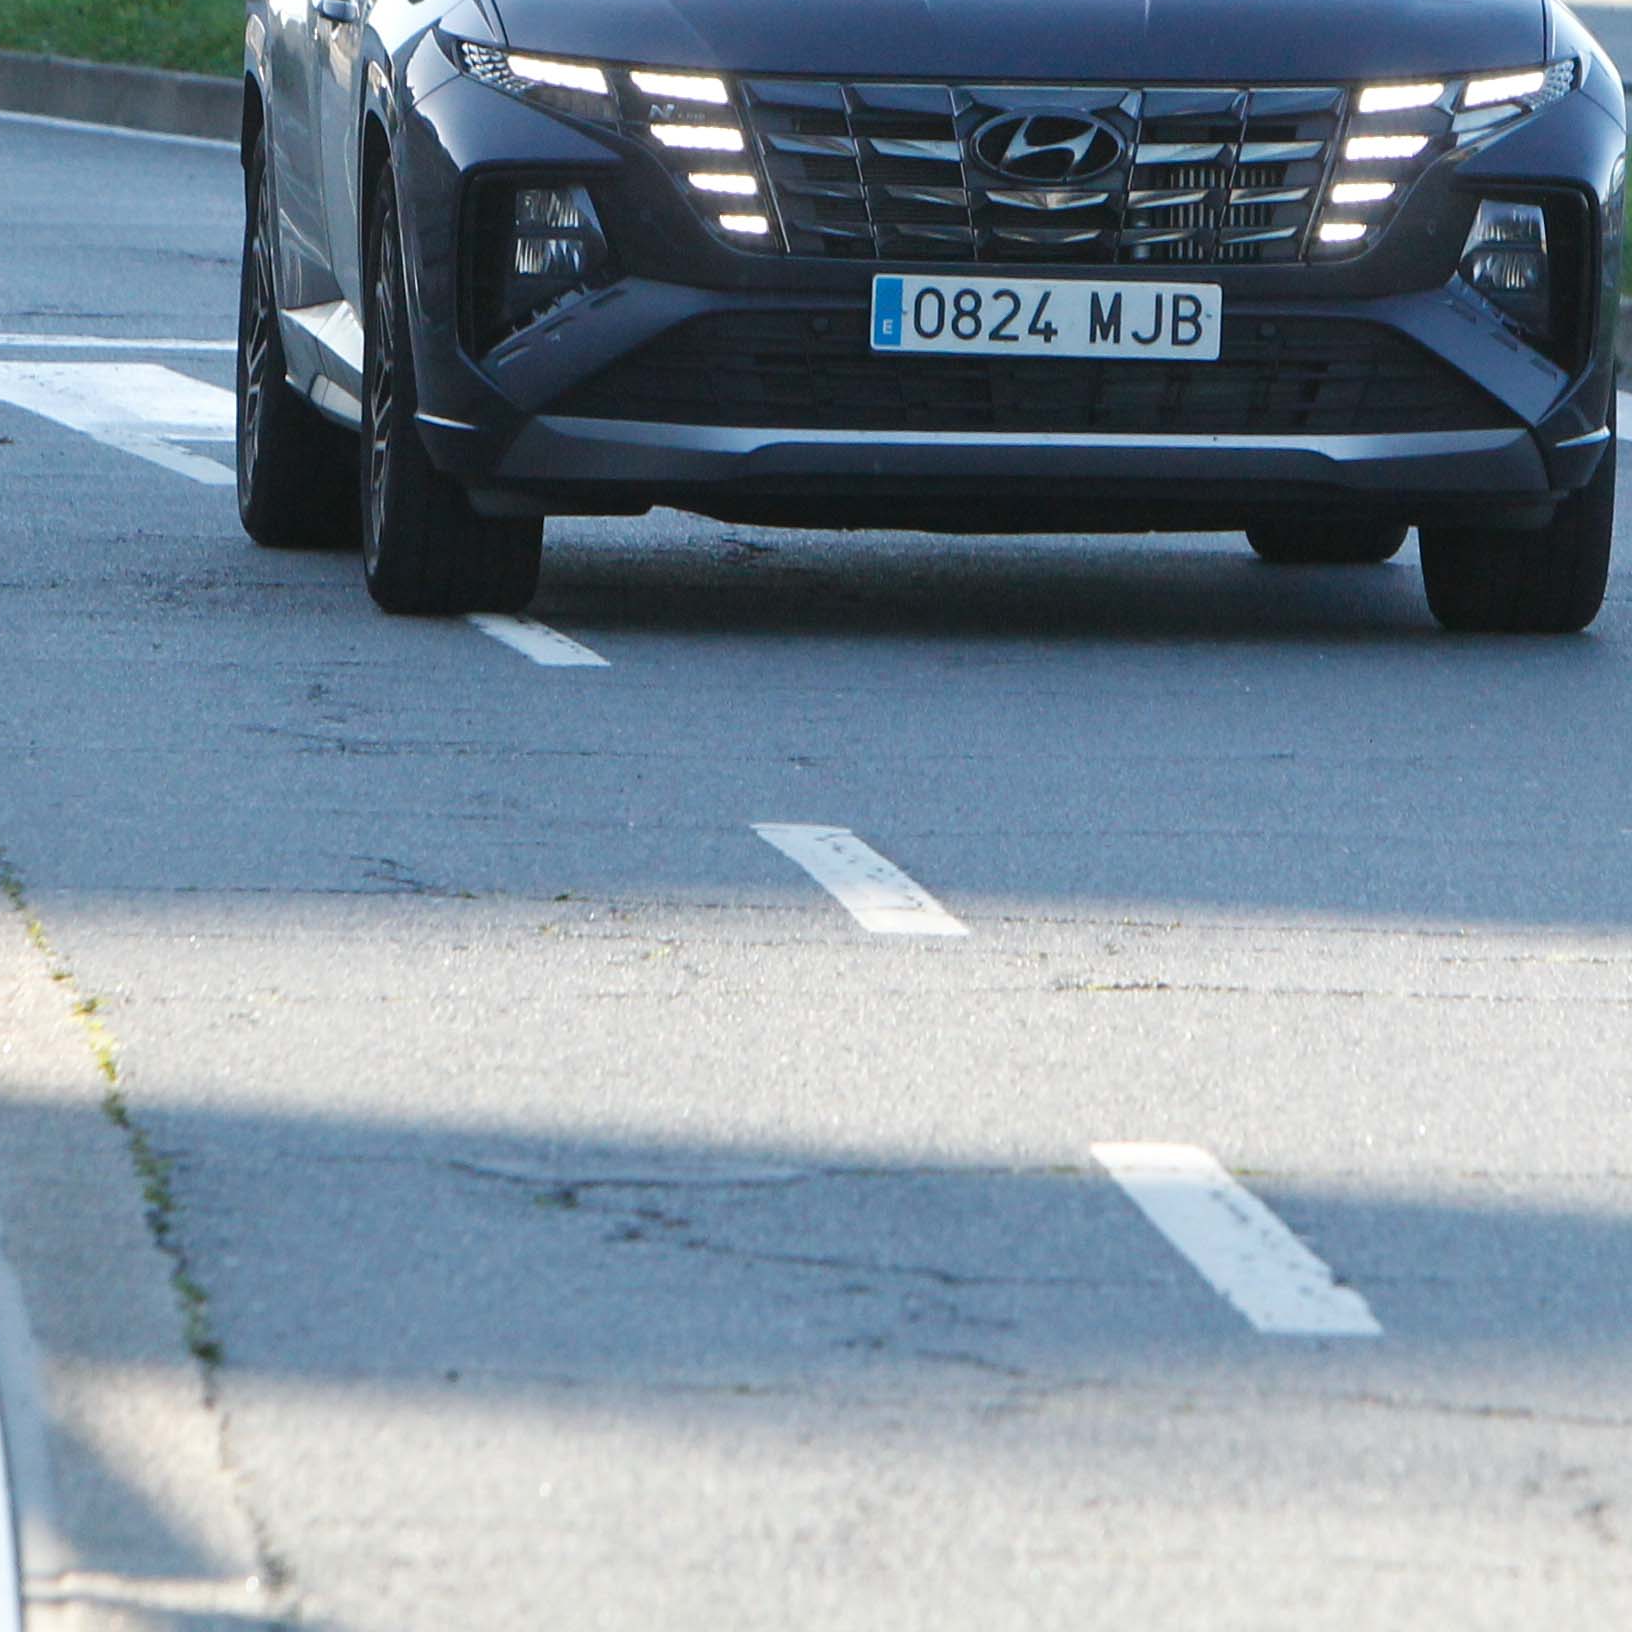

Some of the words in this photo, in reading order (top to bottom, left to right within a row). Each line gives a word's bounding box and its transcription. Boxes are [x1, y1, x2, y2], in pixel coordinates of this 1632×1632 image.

[881, 318, 894, 335] E
[913, 286, 1059, 344] 0824
[1088, 290, 1204, 348] MJB
